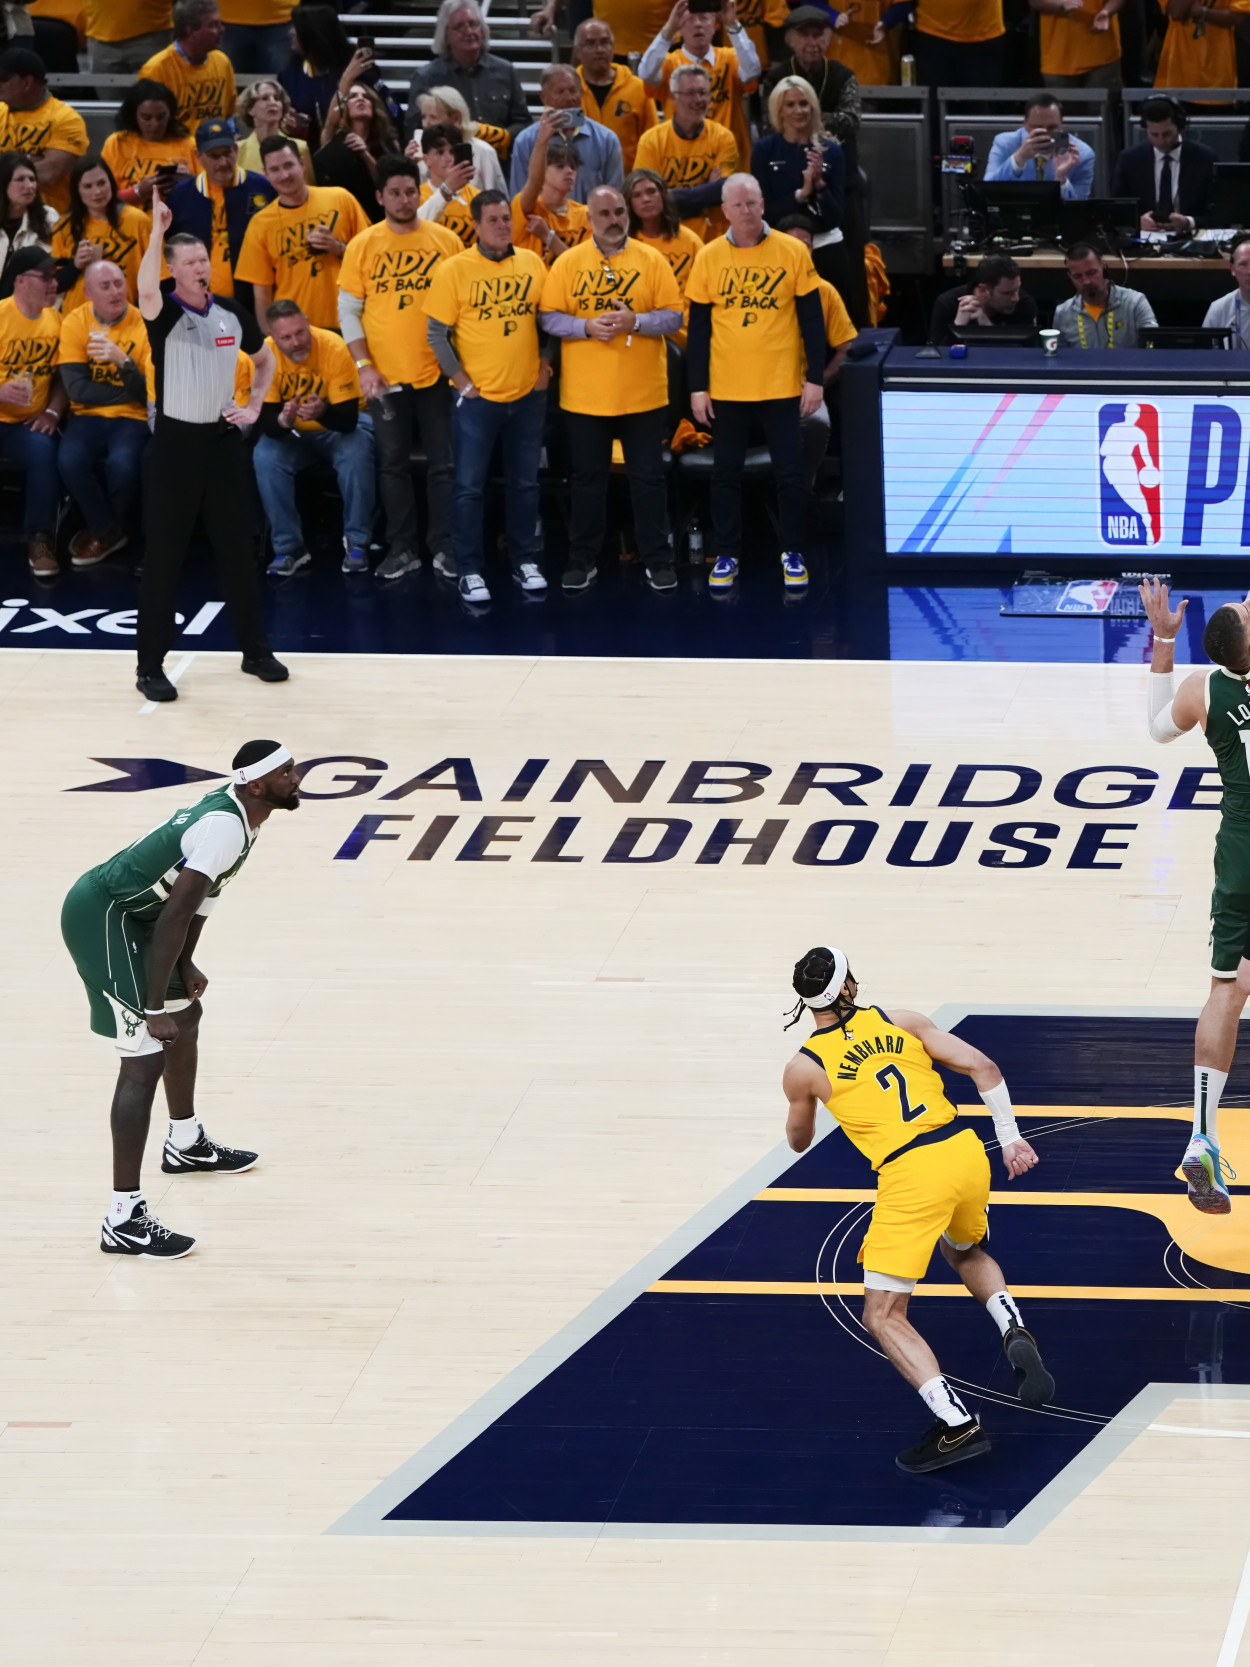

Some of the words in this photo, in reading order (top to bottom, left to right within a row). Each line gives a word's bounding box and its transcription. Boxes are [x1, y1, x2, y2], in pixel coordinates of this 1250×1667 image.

[369, 248, 442, 280] INDY
[376, 278, 389, 294] IS
[394, 276, 433, 292] BACK
[470, 273, 533, 309] INDY
[571, 269, 641, 298] INDY
[716, 266, 788, 297] INDY
[478, 307, 492, 321] IS
[579, 298, 590, 311] IS
[725, 297, 736, 310] IS
[741, 296, 780, 311] BACK
[3, 337, 61, 366] INDY
[1107, 515, 1140, 539] NBA
[294, 756, 1222, 811] GAINBRIDGE
[333, 814, 1139, 870] FIELDHOUSE
[837, 1035, 905, 1081] NEMBHARD
[875, 1063, 928, 1123] 2
